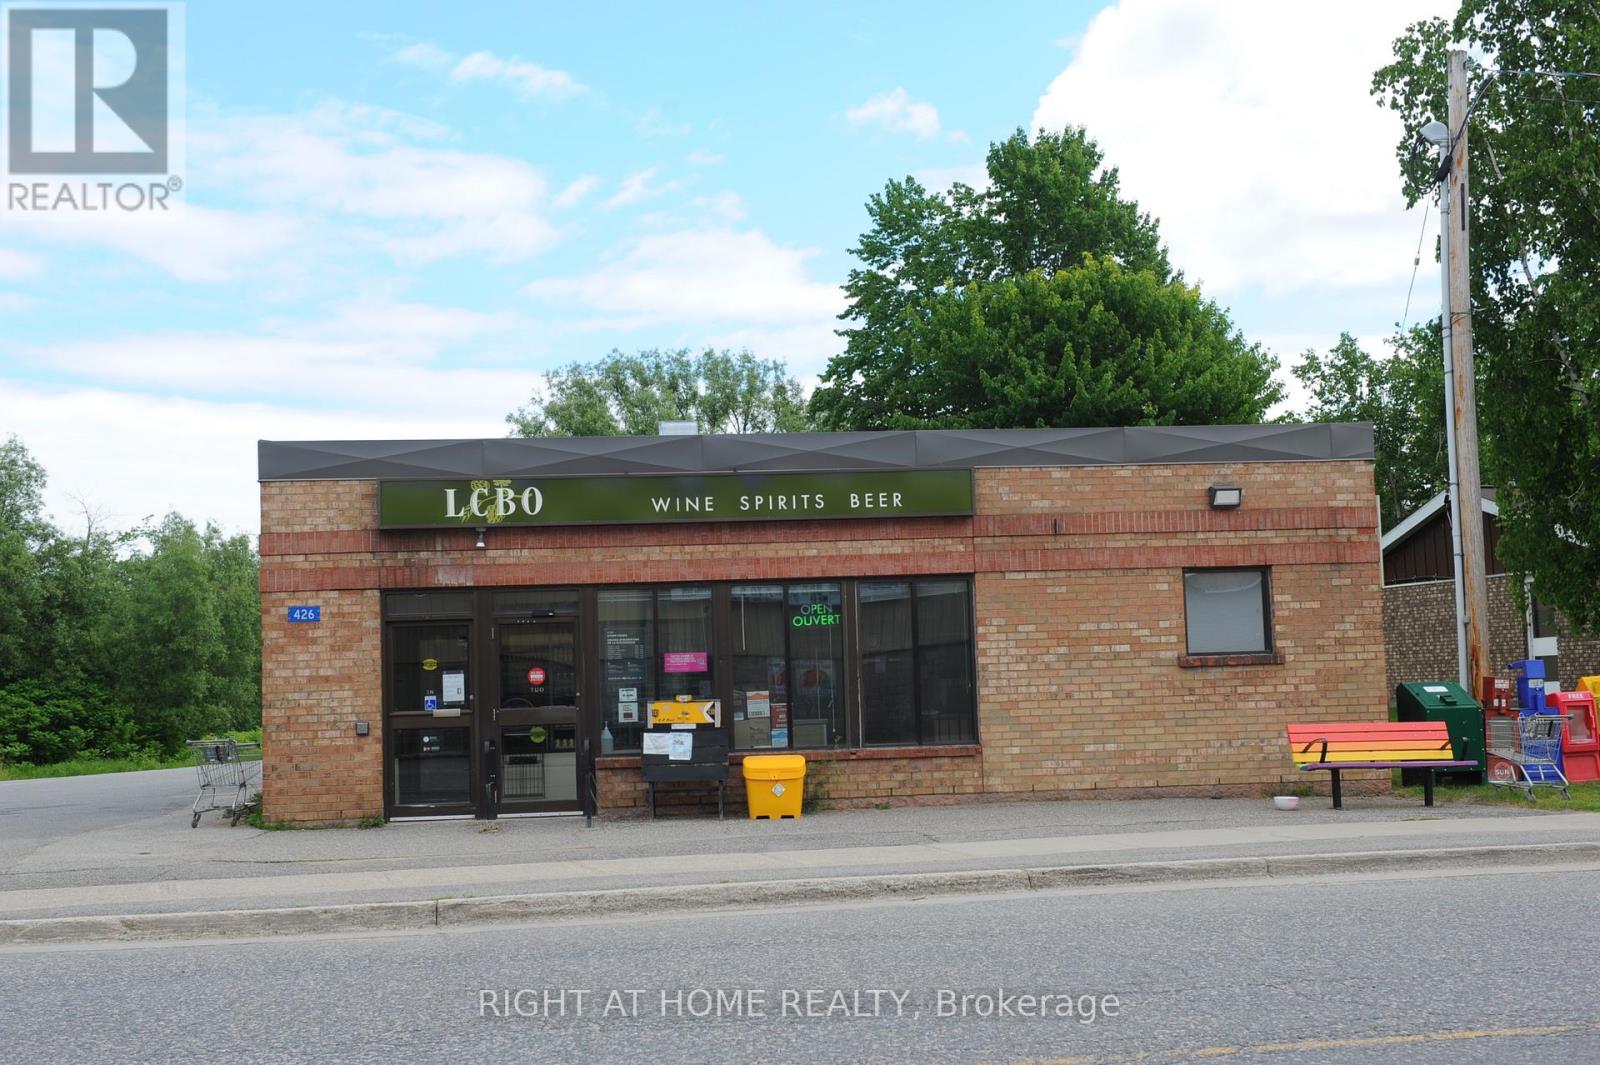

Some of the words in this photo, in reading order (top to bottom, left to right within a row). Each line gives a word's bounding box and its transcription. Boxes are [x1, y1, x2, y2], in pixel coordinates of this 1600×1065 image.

[445, 486, 543, 517] LCBO
[651, 496, 714, 513] WINE
[740, 494, 825, 511] SPIRITS
[850, 492, 903, 509] BEER
[293, 608, 315, 620] 426
[801, 603, 833, 615] OPEN
[793, 614, 840, 627] OUVERT
